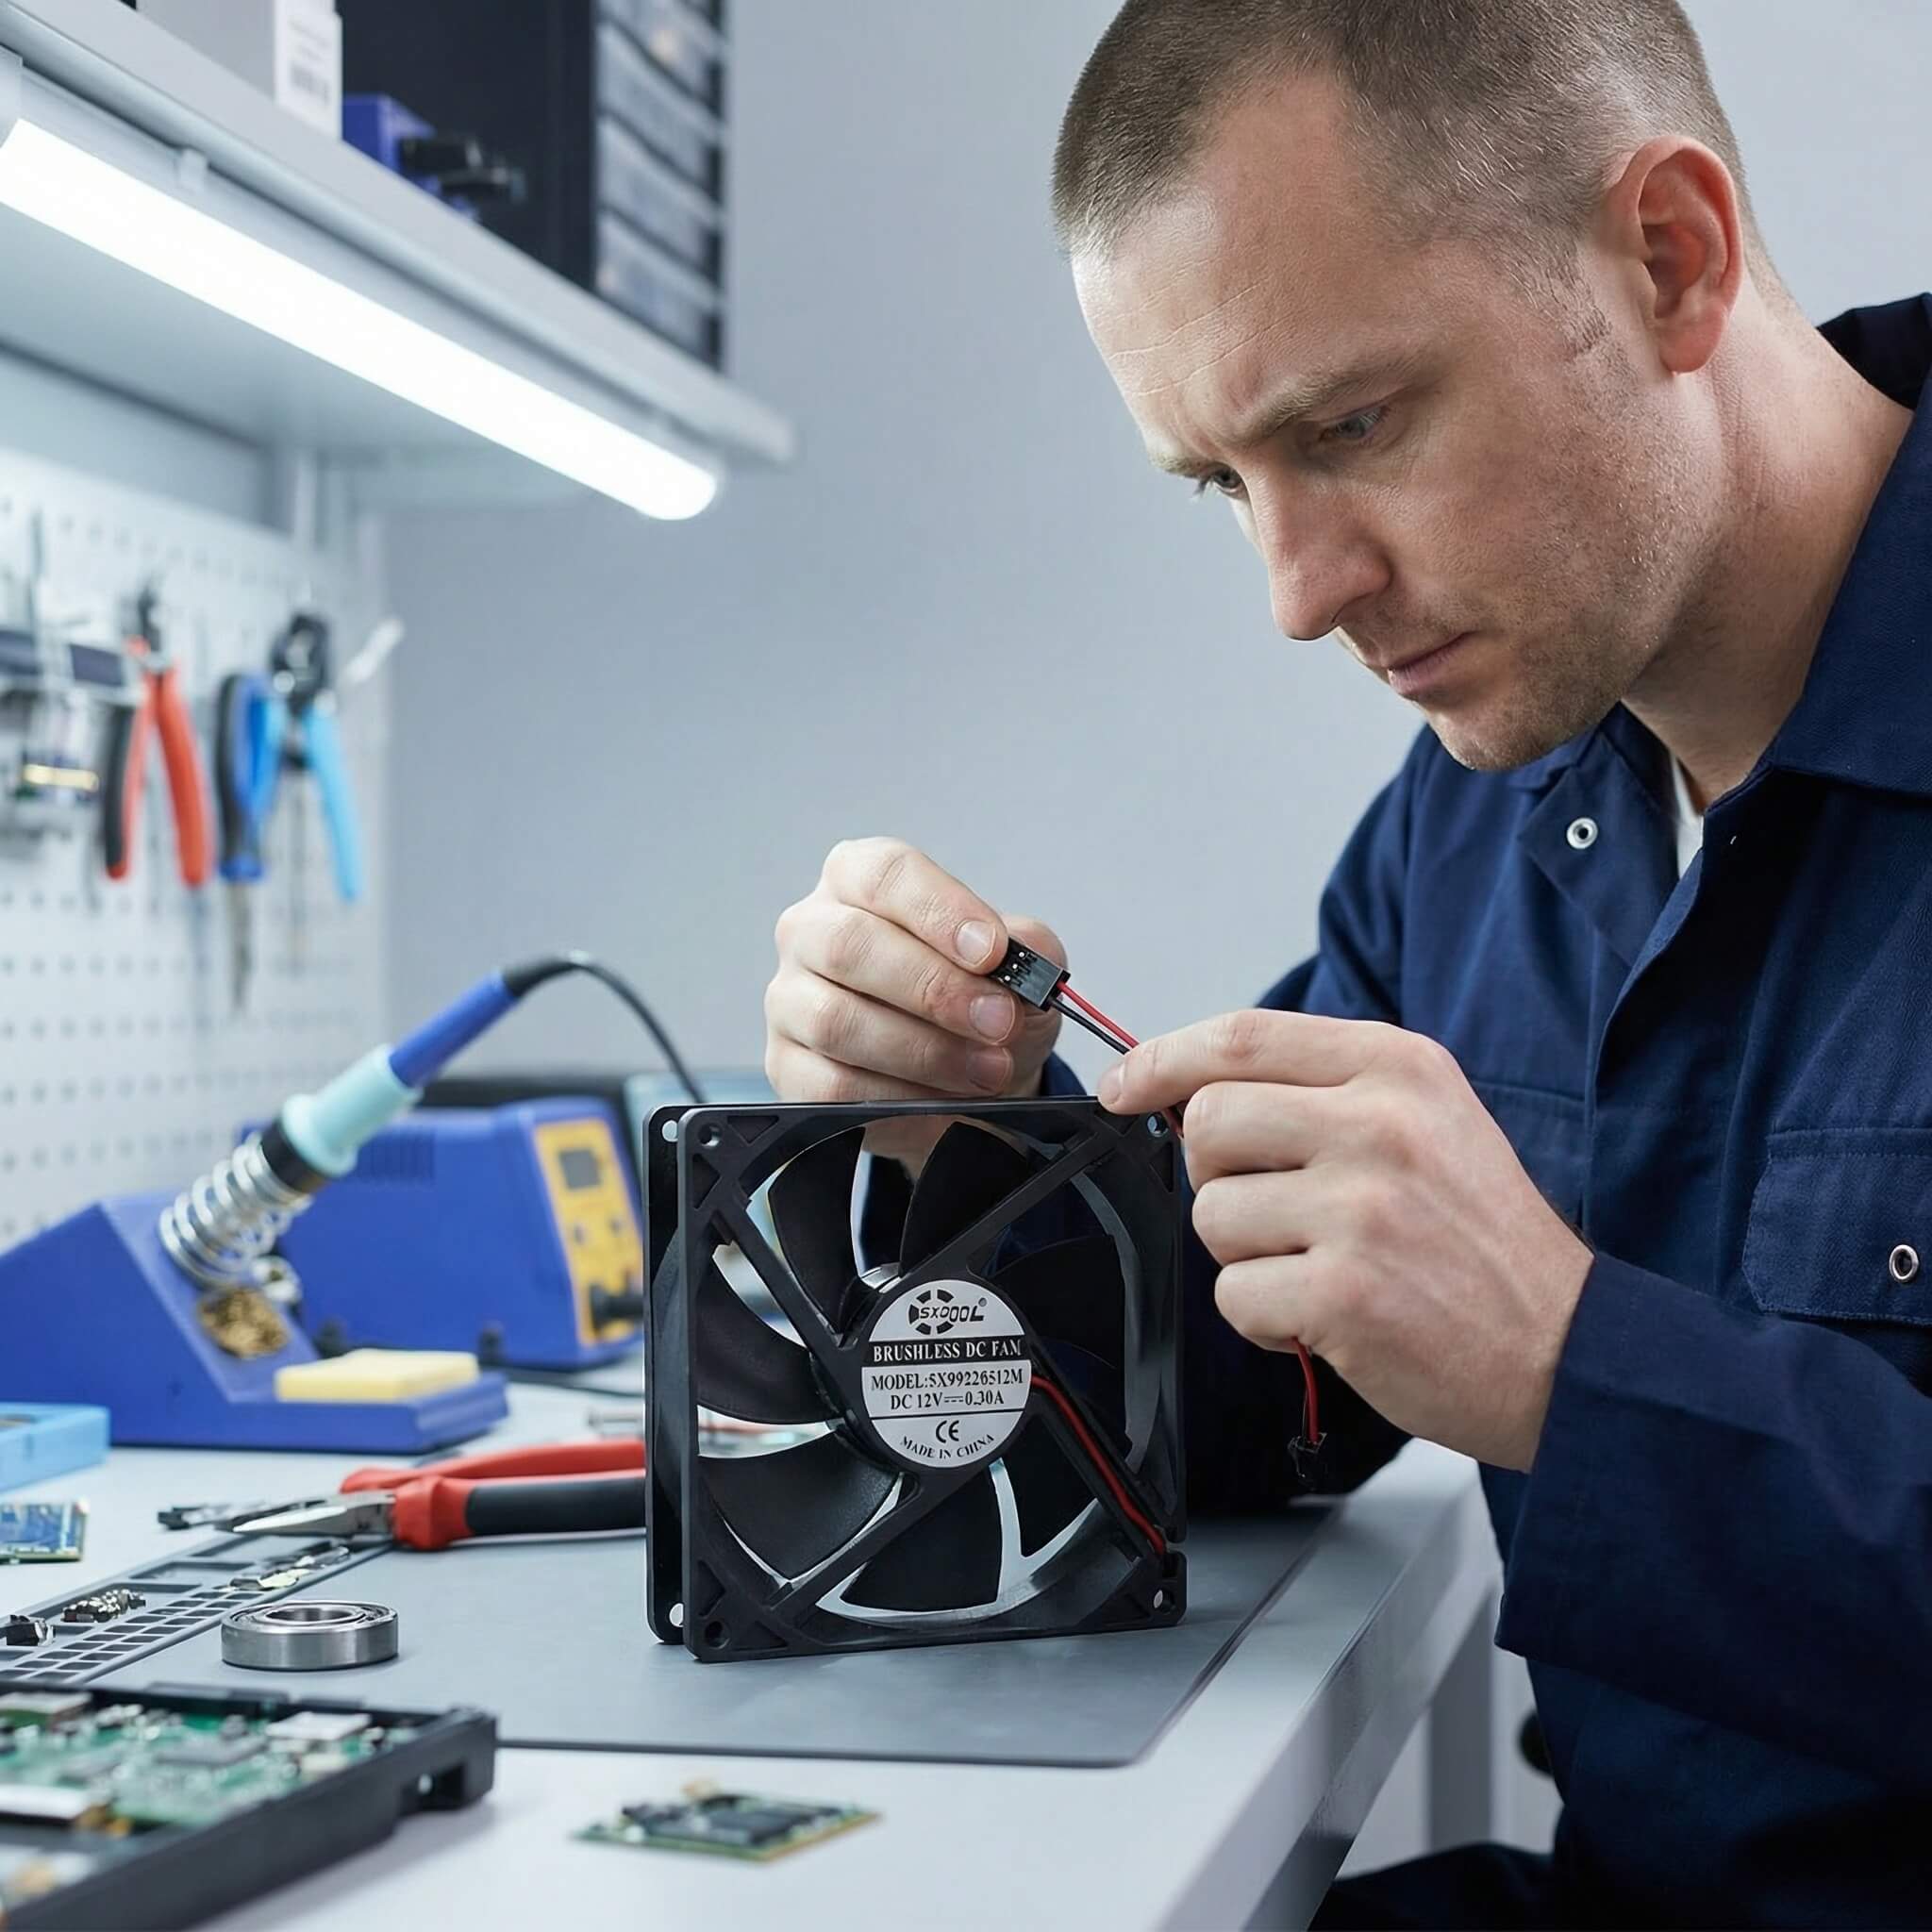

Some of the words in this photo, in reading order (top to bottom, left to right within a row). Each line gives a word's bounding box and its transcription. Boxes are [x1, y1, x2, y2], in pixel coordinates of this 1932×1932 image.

[874, 1342, 960, 1362] BRUSHLESS
[966, 1341, 986, 1357] DC
[991, 1339, 1021, 1357] FAN
[891, 1394, 912, 1409] DC
[936, 1420, 959, 1443] CE
[900, 1436, 935, 1458] MADE
[939, 1448, 952, 1459] IN
[957, 1434, 994, 1457] CHINA
